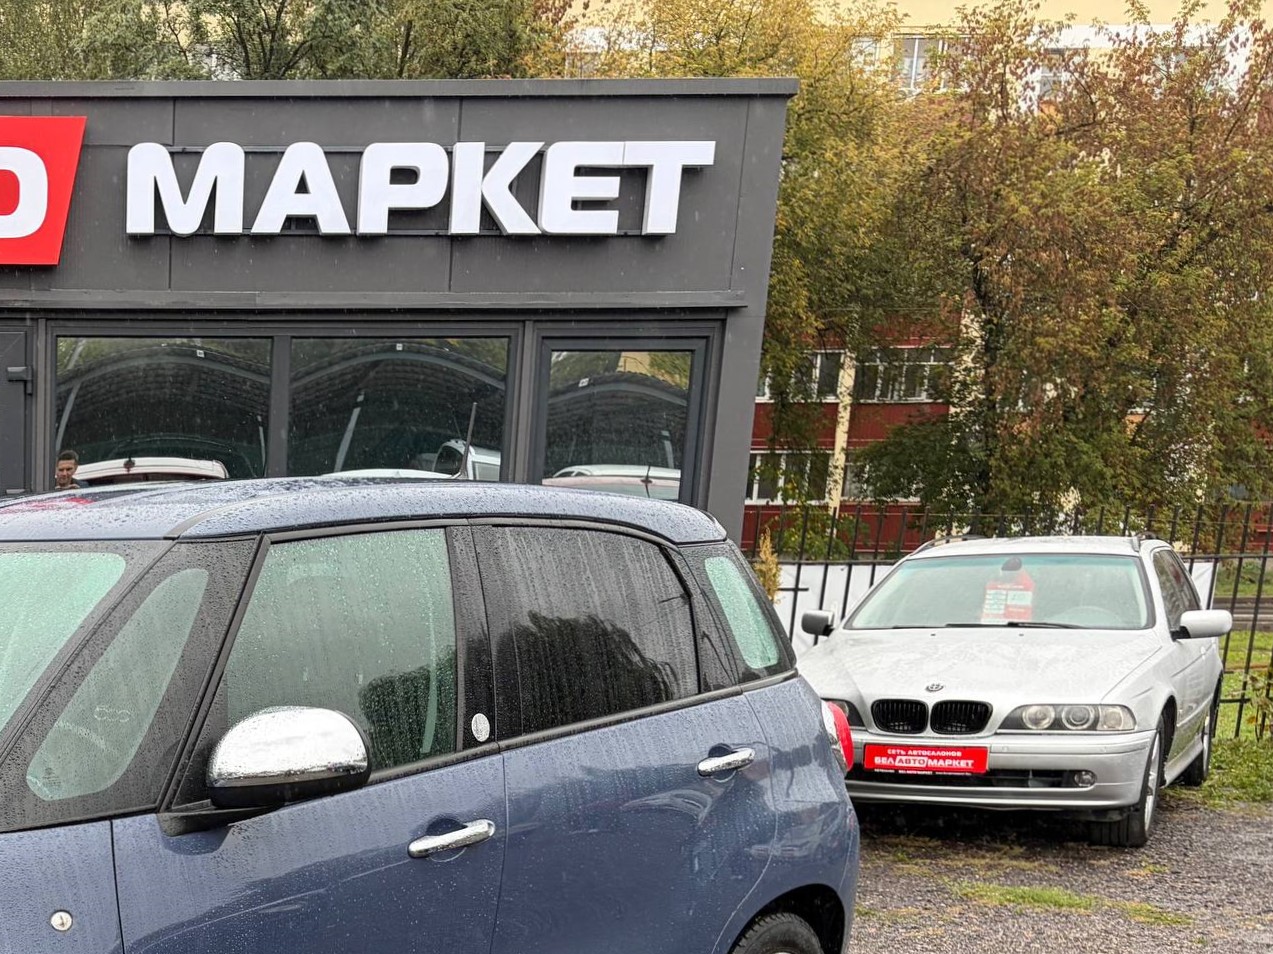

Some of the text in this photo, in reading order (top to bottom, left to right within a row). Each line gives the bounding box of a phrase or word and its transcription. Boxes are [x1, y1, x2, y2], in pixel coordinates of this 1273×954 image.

[127, 140, 716, 237] МАРКЕТ
[874, 756, 975, 768] БЕЛ АВТО МАРКЕТ
